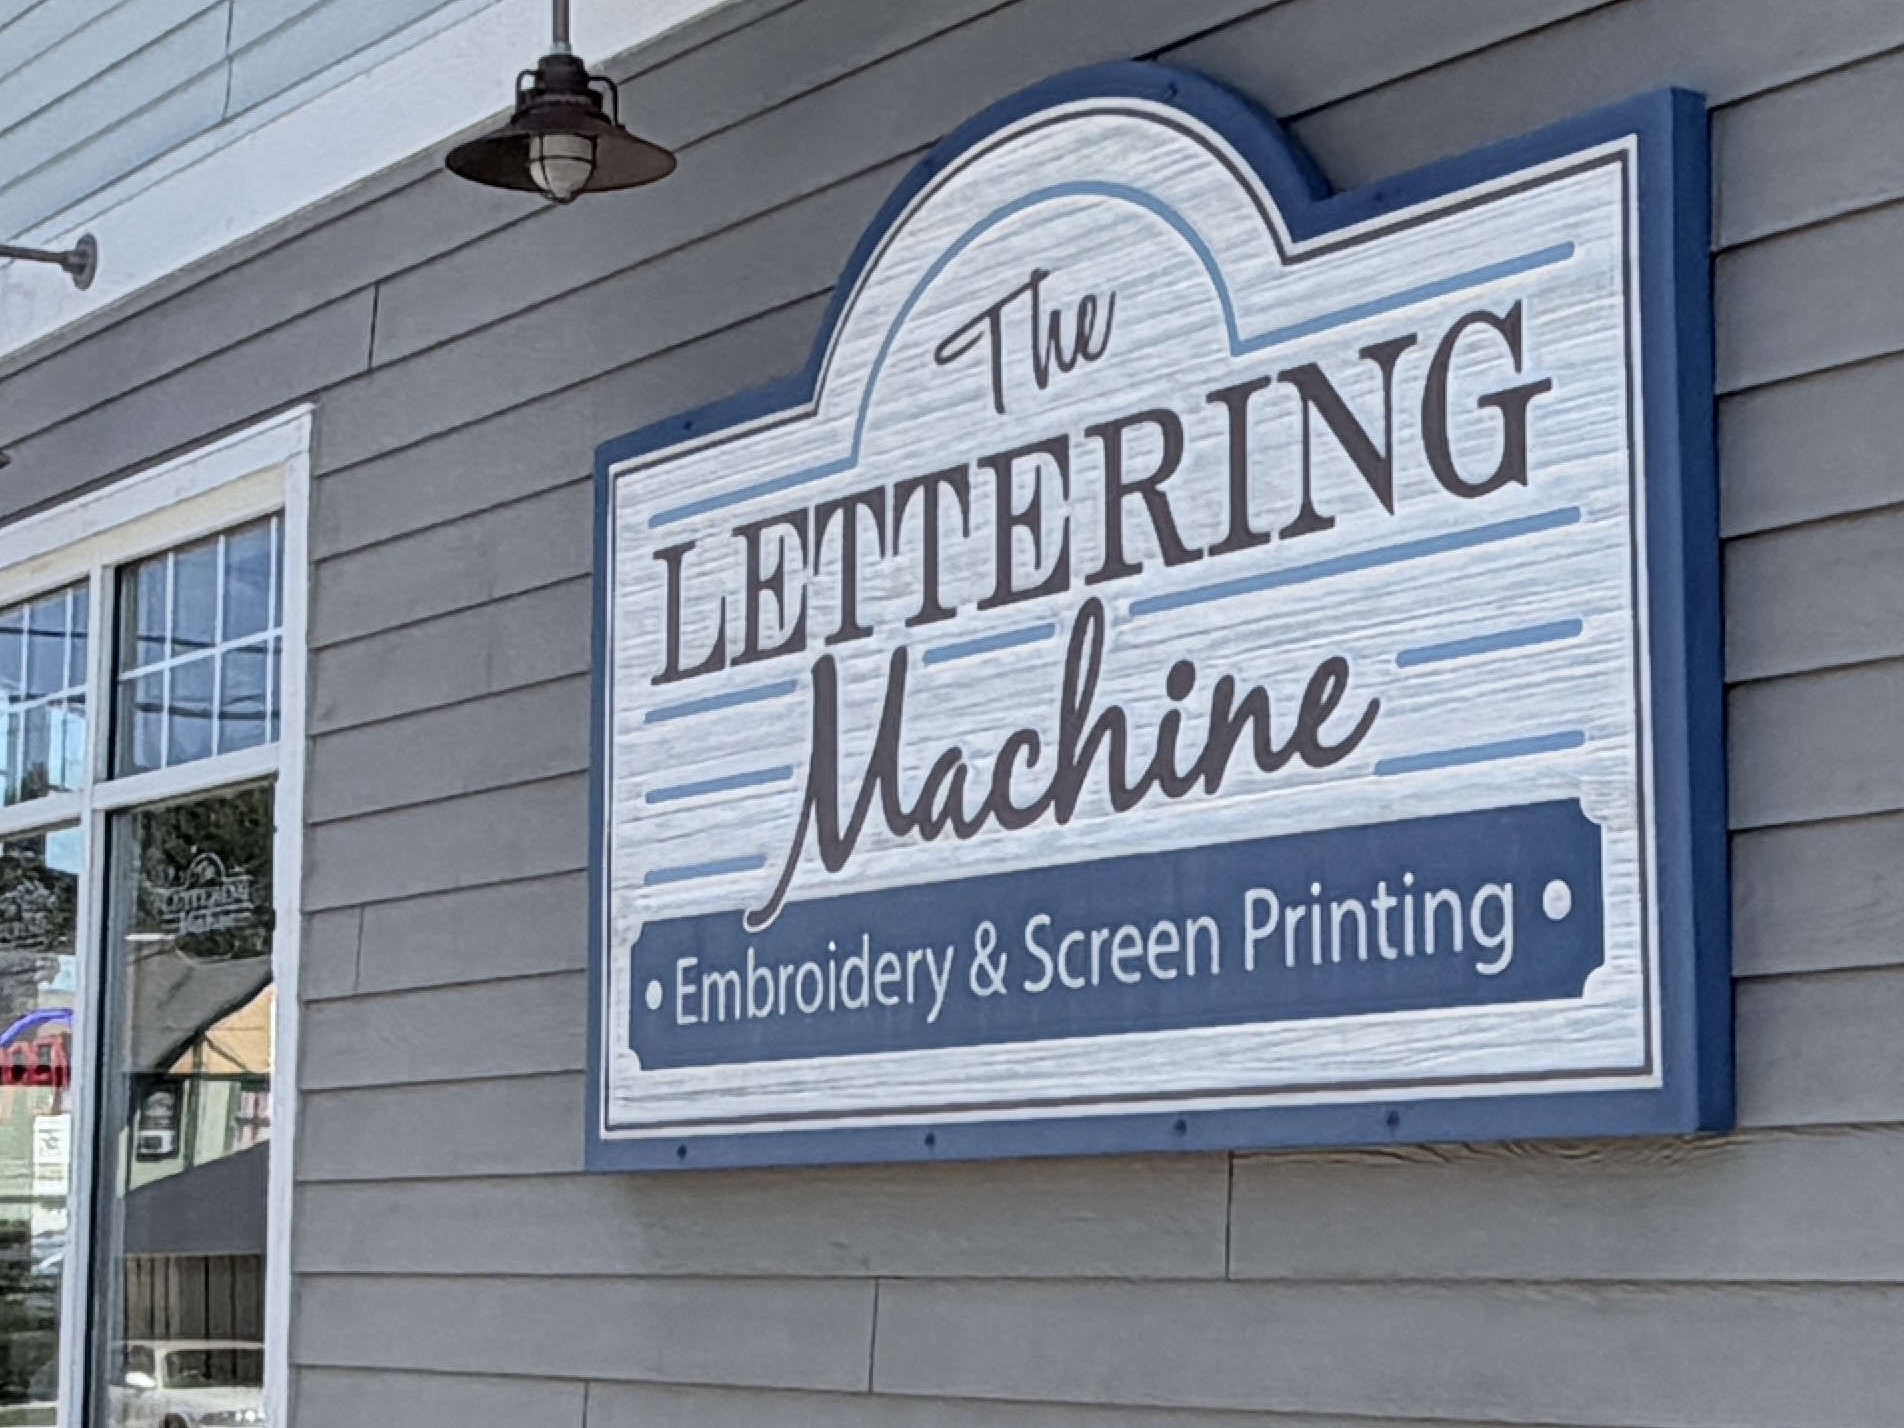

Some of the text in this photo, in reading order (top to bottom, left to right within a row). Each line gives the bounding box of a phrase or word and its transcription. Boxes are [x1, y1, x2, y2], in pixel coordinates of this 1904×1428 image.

[934, 267, 1116, 415] The
[650, 298, 1554, 686] LETTERING
[745, 595, 1382, 928] Machine
[673, 871, 1516, 1026] Embroidery & Screen Printing
